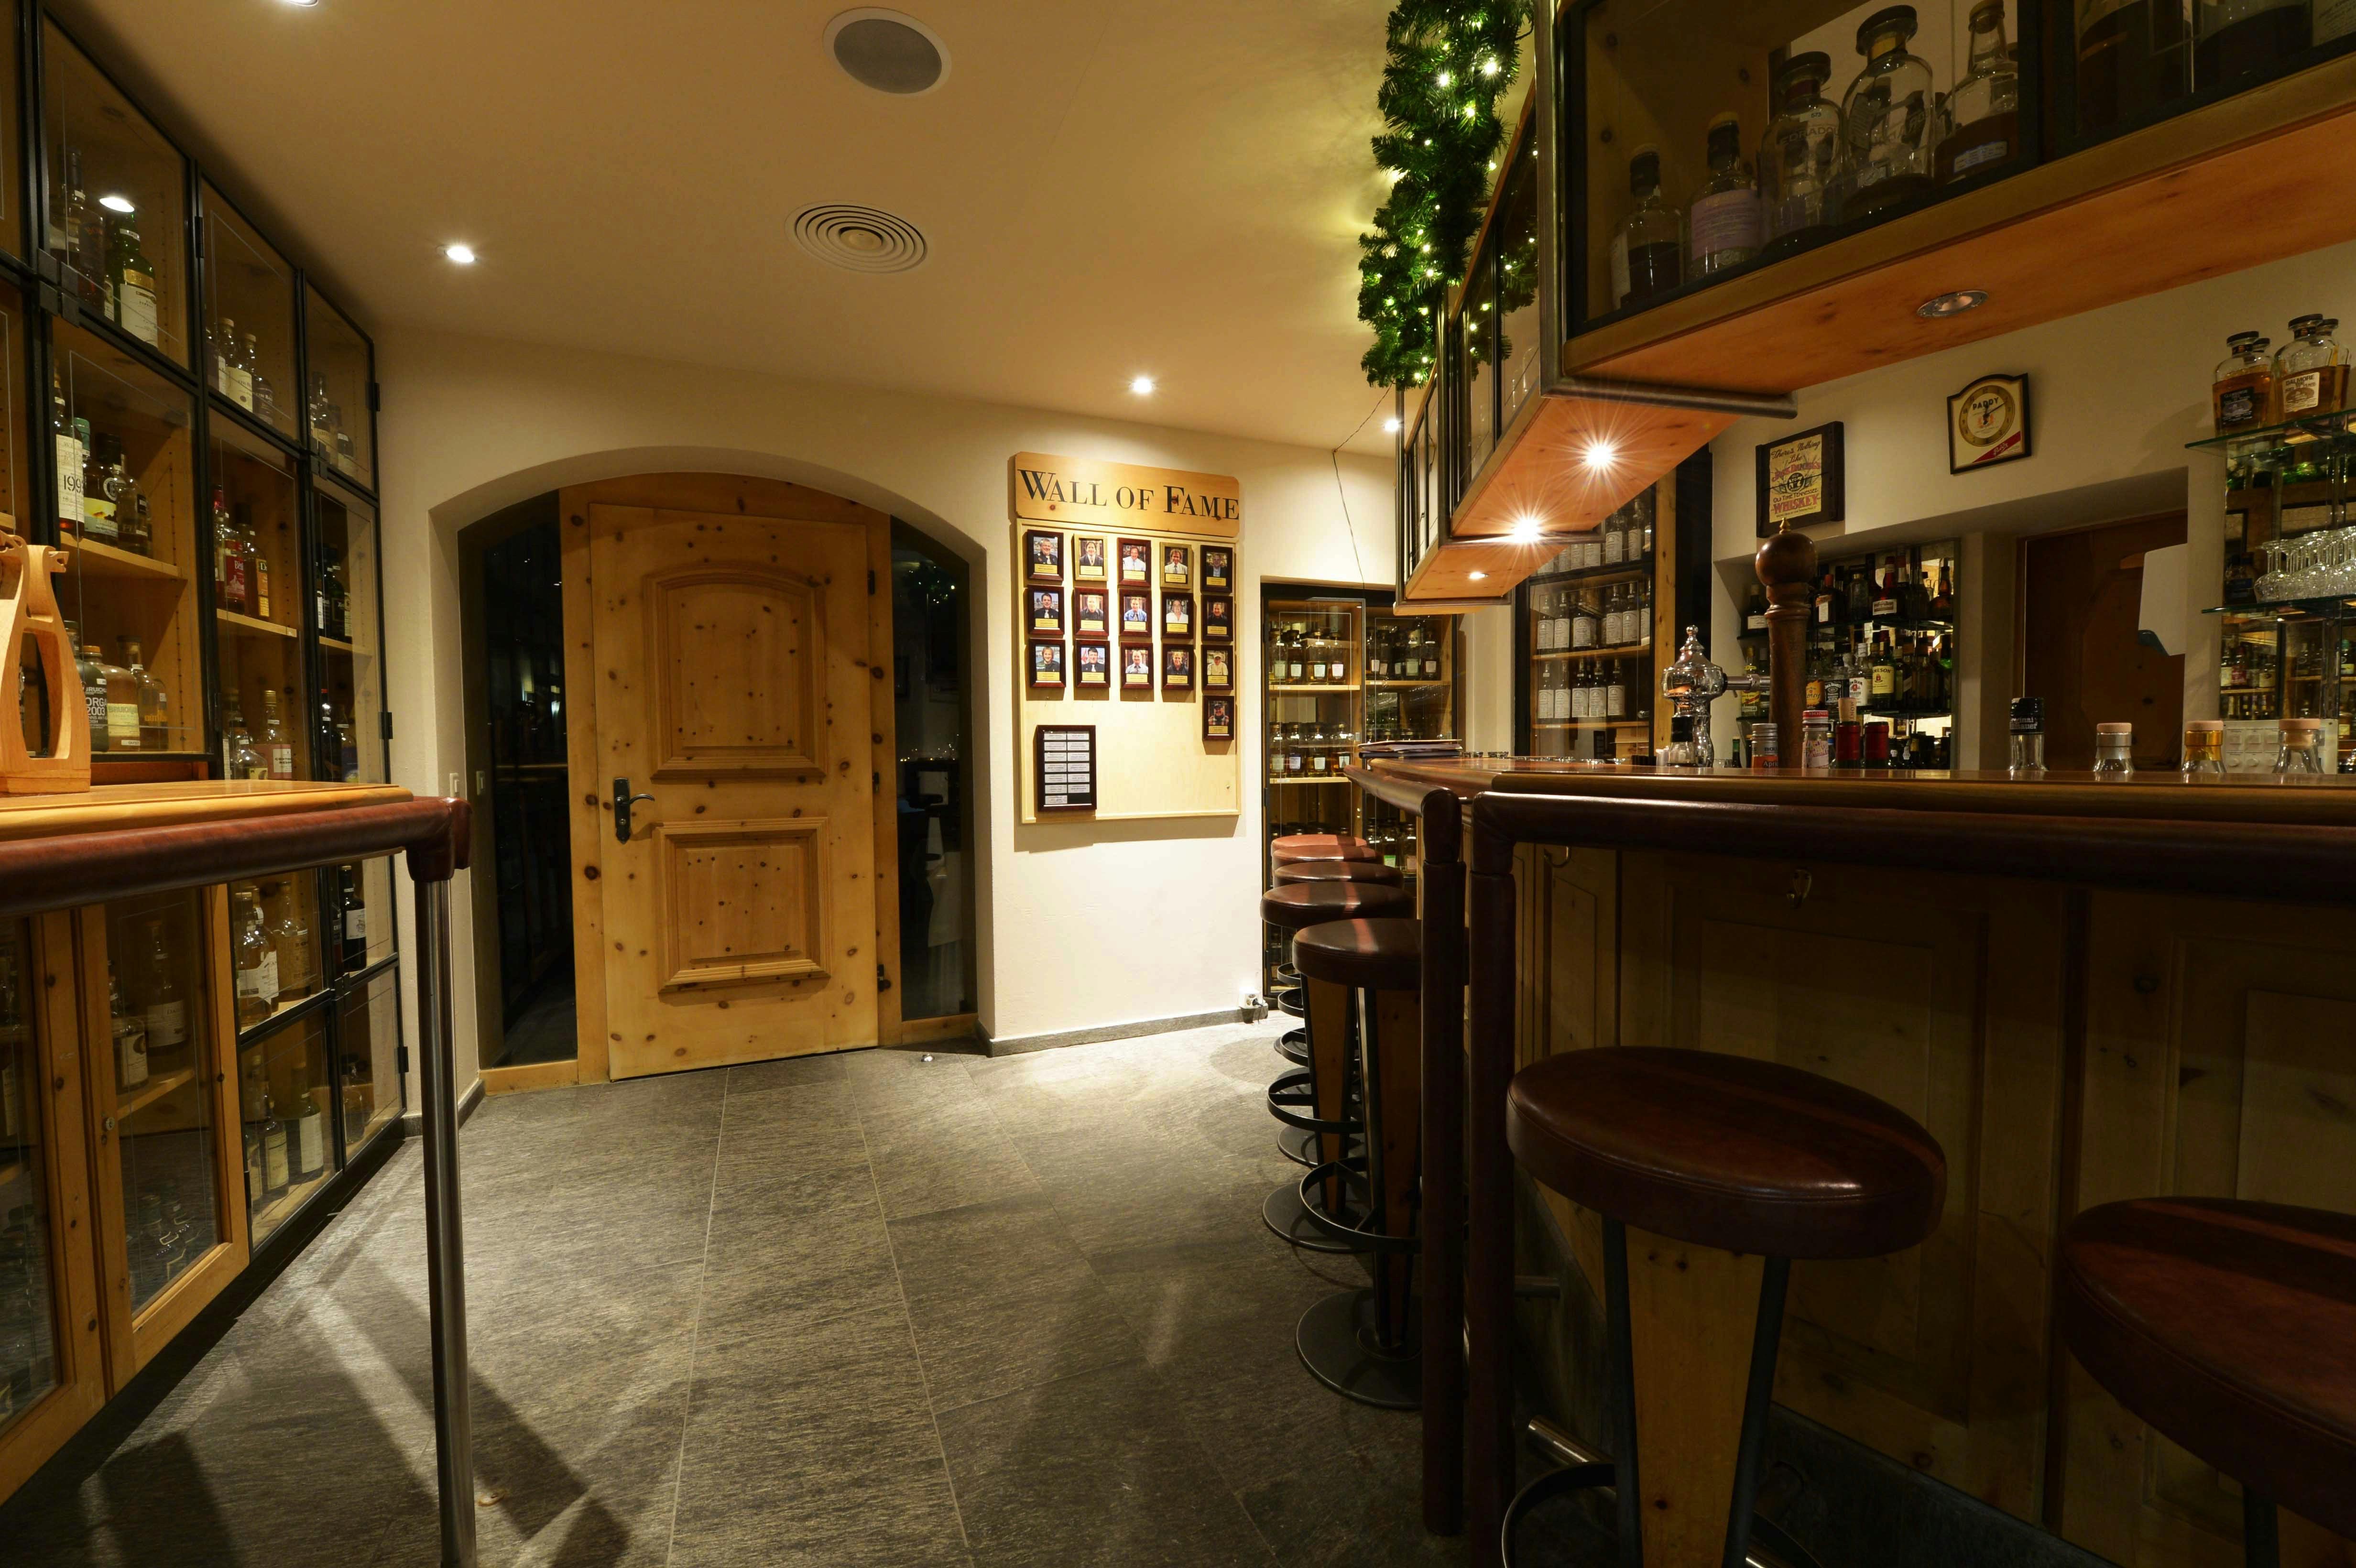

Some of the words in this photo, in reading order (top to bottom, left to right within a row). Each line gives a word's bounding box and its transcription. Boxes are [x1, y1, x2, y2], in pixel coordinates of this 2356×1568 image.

[2286, 374, 2314, 386] DALMORE
[1973, 397, 1999, 410] PADDY
[1798, 440, 1821, 451] Nothing
[1789, 454, 1802, 464] Like
[1017, 469, 1107, 507] WALL
[1116, 487, 1154, 511] OF
[1163, 485, 1239, 520] FAME
[1773, 494, 1819, 514] WHISKEY
[87, 707, 106, 716] 2003
